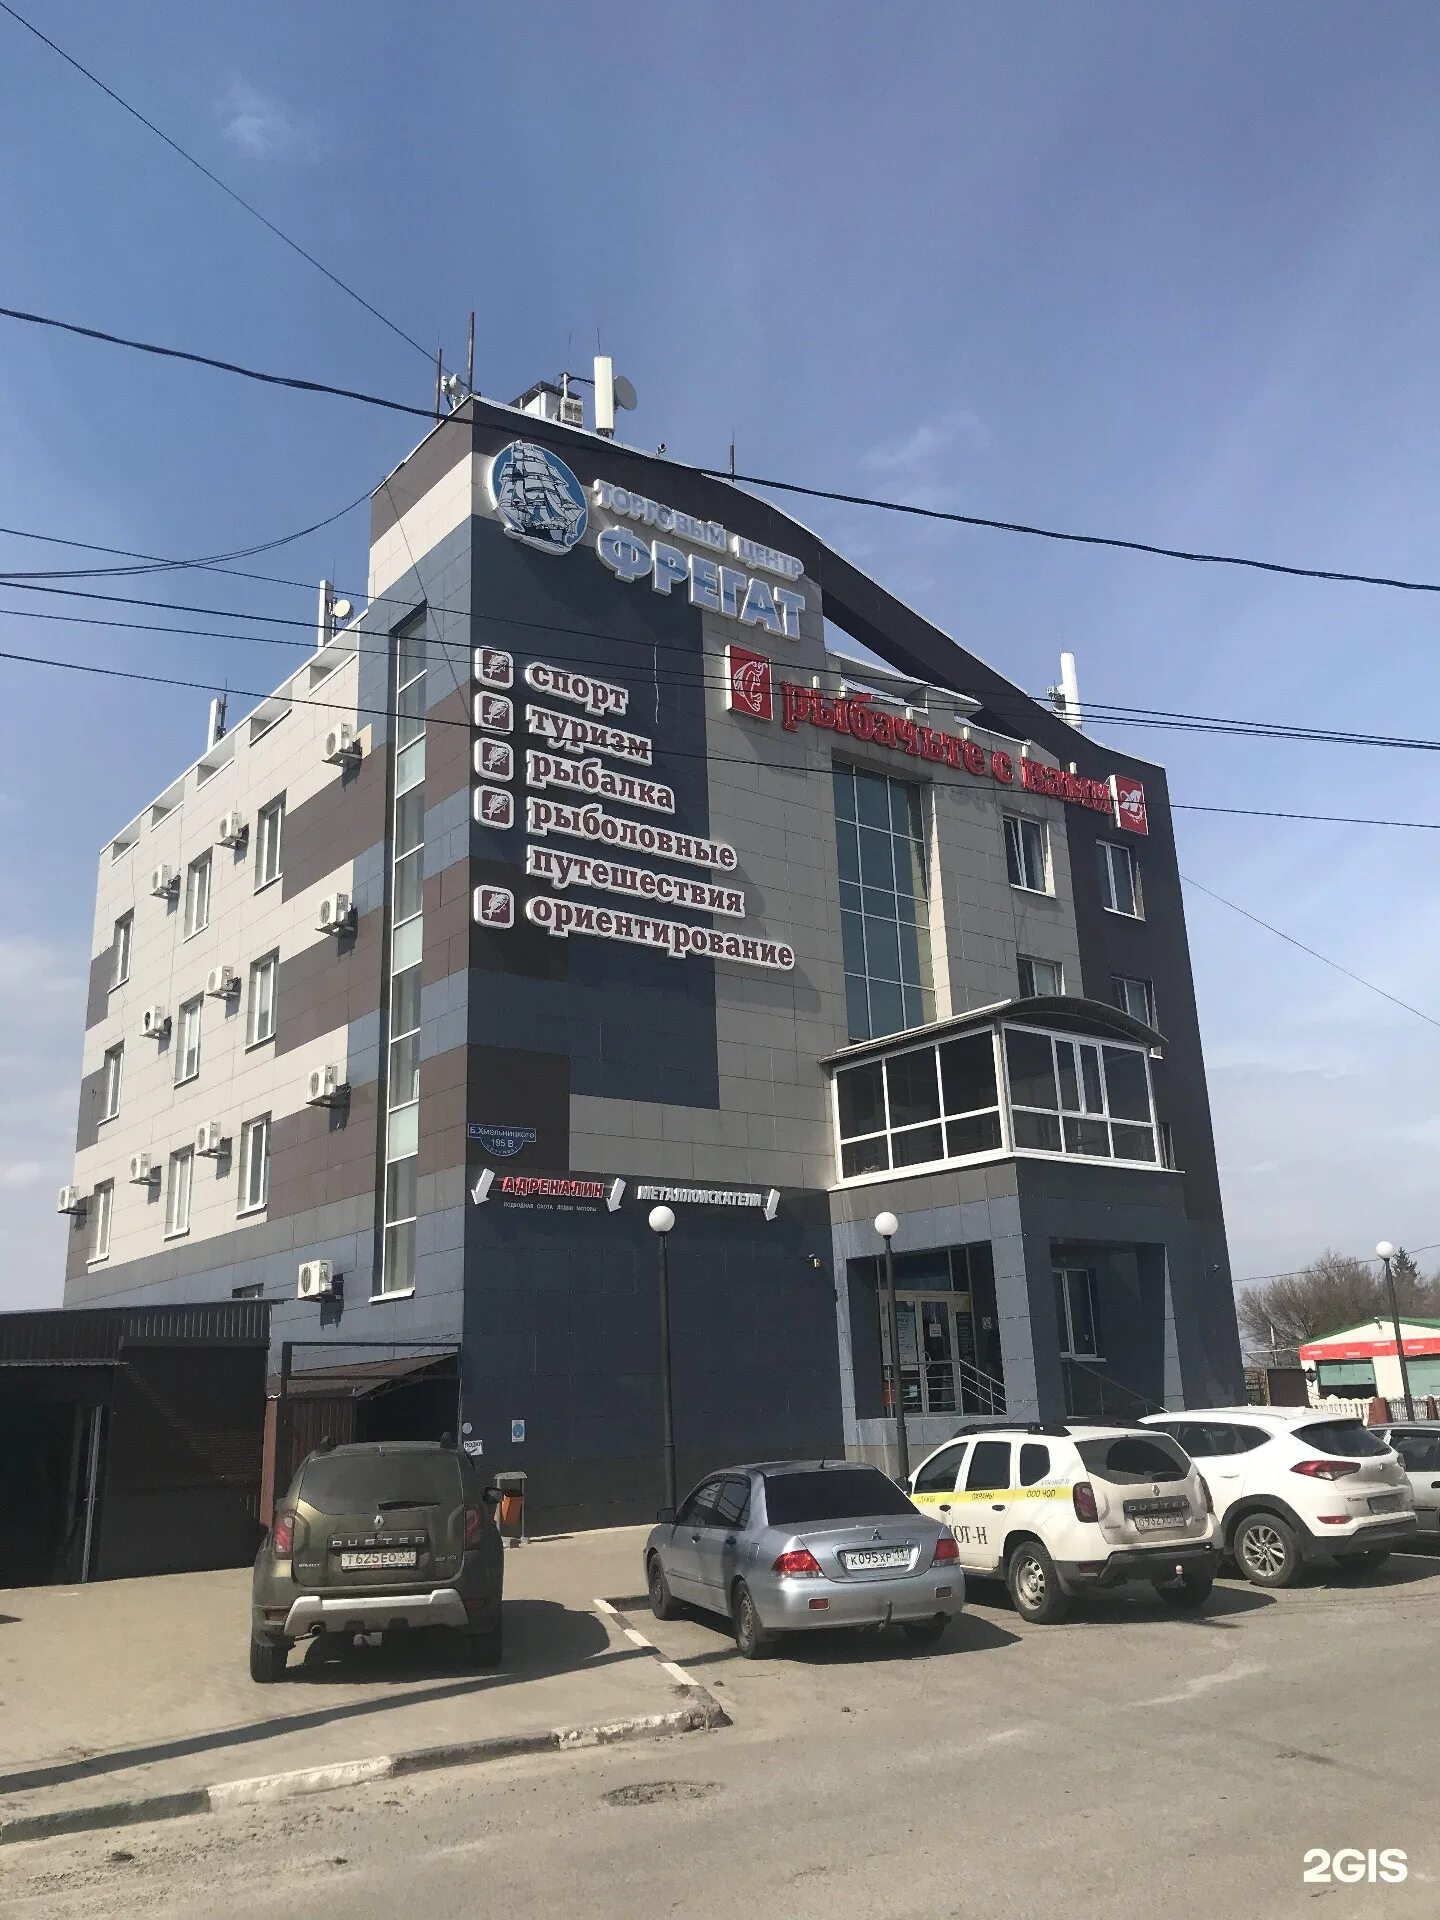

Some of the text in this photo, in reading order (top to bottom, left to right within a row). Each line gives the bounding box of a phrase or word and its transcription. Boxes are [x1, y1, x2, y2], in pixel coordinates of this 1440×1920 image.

[594, 479, 804, 581] ТОРГОВЫЙ ЦЕНТР
[598, 525, 805, 640] ФРЕГАТ
[526, 662, 629, 715] спорт
[527, 704, 652, 766] туризм
[781, 681, 985, 775] рыбачьте
[992, 751, 1014, 784] с
[527, 749, 675, 814] рыбалка
[527, 796, 737, 871] рыболовные
[527, 845, 745, 918] путешествия
[526, 896, 795, 970] ориентирование
[501, 1176, 604, 1198] АДРЕНАЛИН
[637, 1185, 762, 1207] МЕТАЛЛОИСКАТЕЛИ
[332, 1536, 425, 1547] DUSTER
